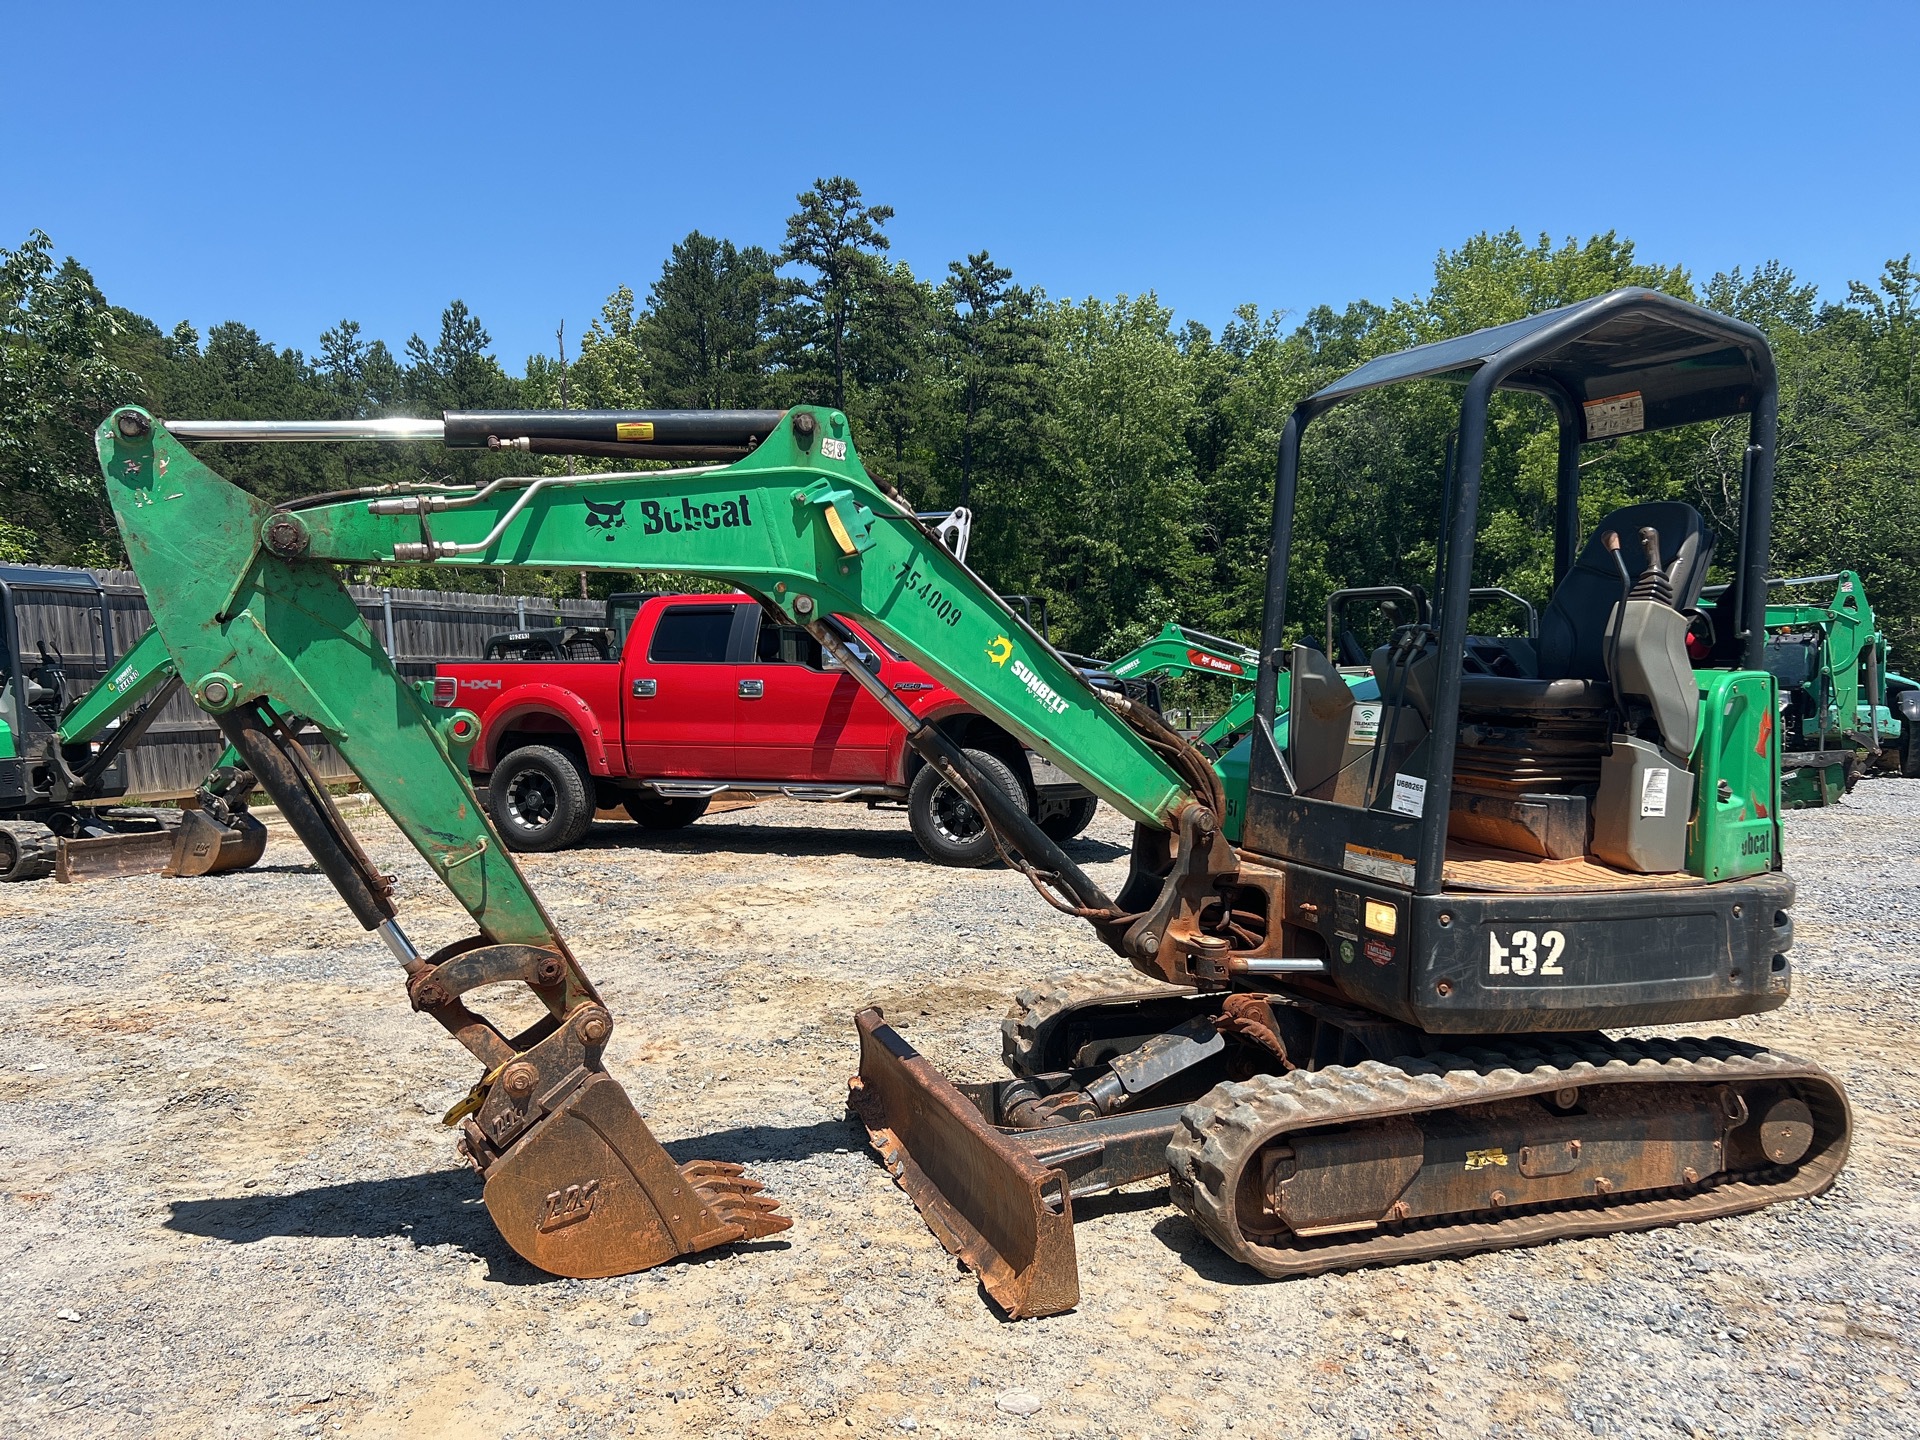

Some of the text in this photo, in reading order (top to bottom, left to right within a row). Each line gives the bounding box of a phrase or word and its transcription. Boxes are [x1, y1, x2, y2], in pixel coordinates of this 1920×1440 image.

[640, 494, 752, 535] Bobcat
[895, 561, 962, 627] 754009
[1210, 659, 1232, 671] Bobcat
[1010, 660, 1070, 715] SUNBELT
[1741, 830, 1769, 856] obcat
[1488, 930, 1566, 977] E32
